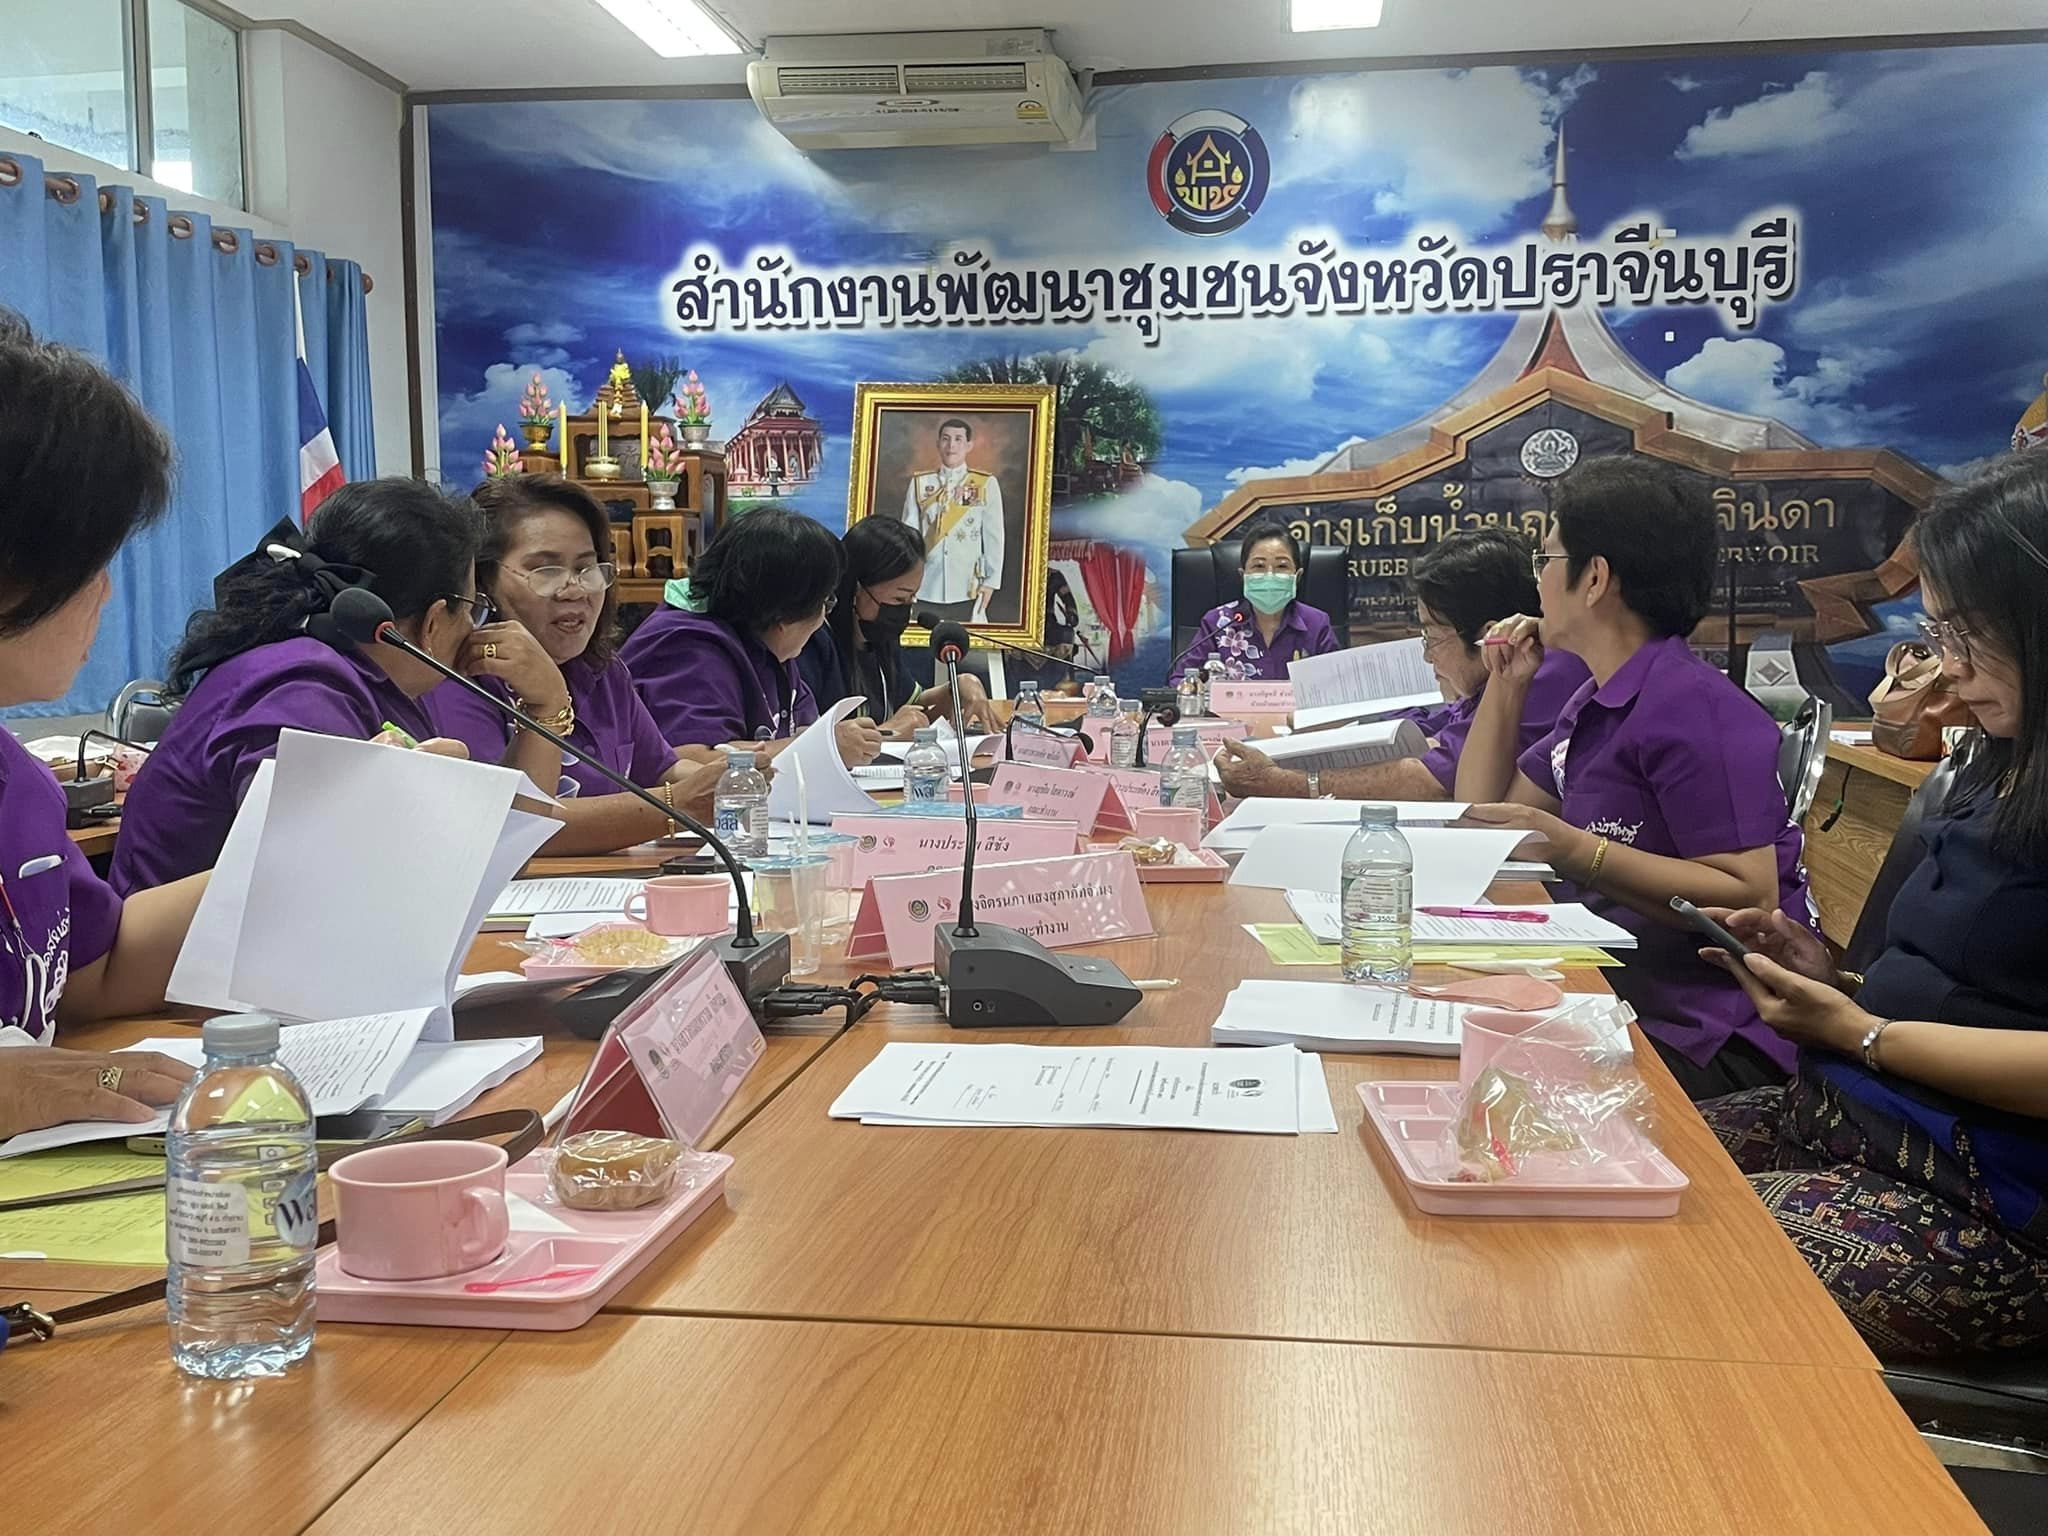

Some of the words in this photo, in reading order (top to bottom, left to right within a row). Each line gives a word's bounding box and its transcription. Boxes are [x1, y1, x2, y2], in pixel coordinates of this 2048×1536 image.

[672, 217, 1798, 338] สำนักงานพัฒนาชุมชนจังหวัดปราจีนบุรี
[1348, 558, 1409, 577] RUEB
[1011, 920, 1070, 938] ณะทำงาน
